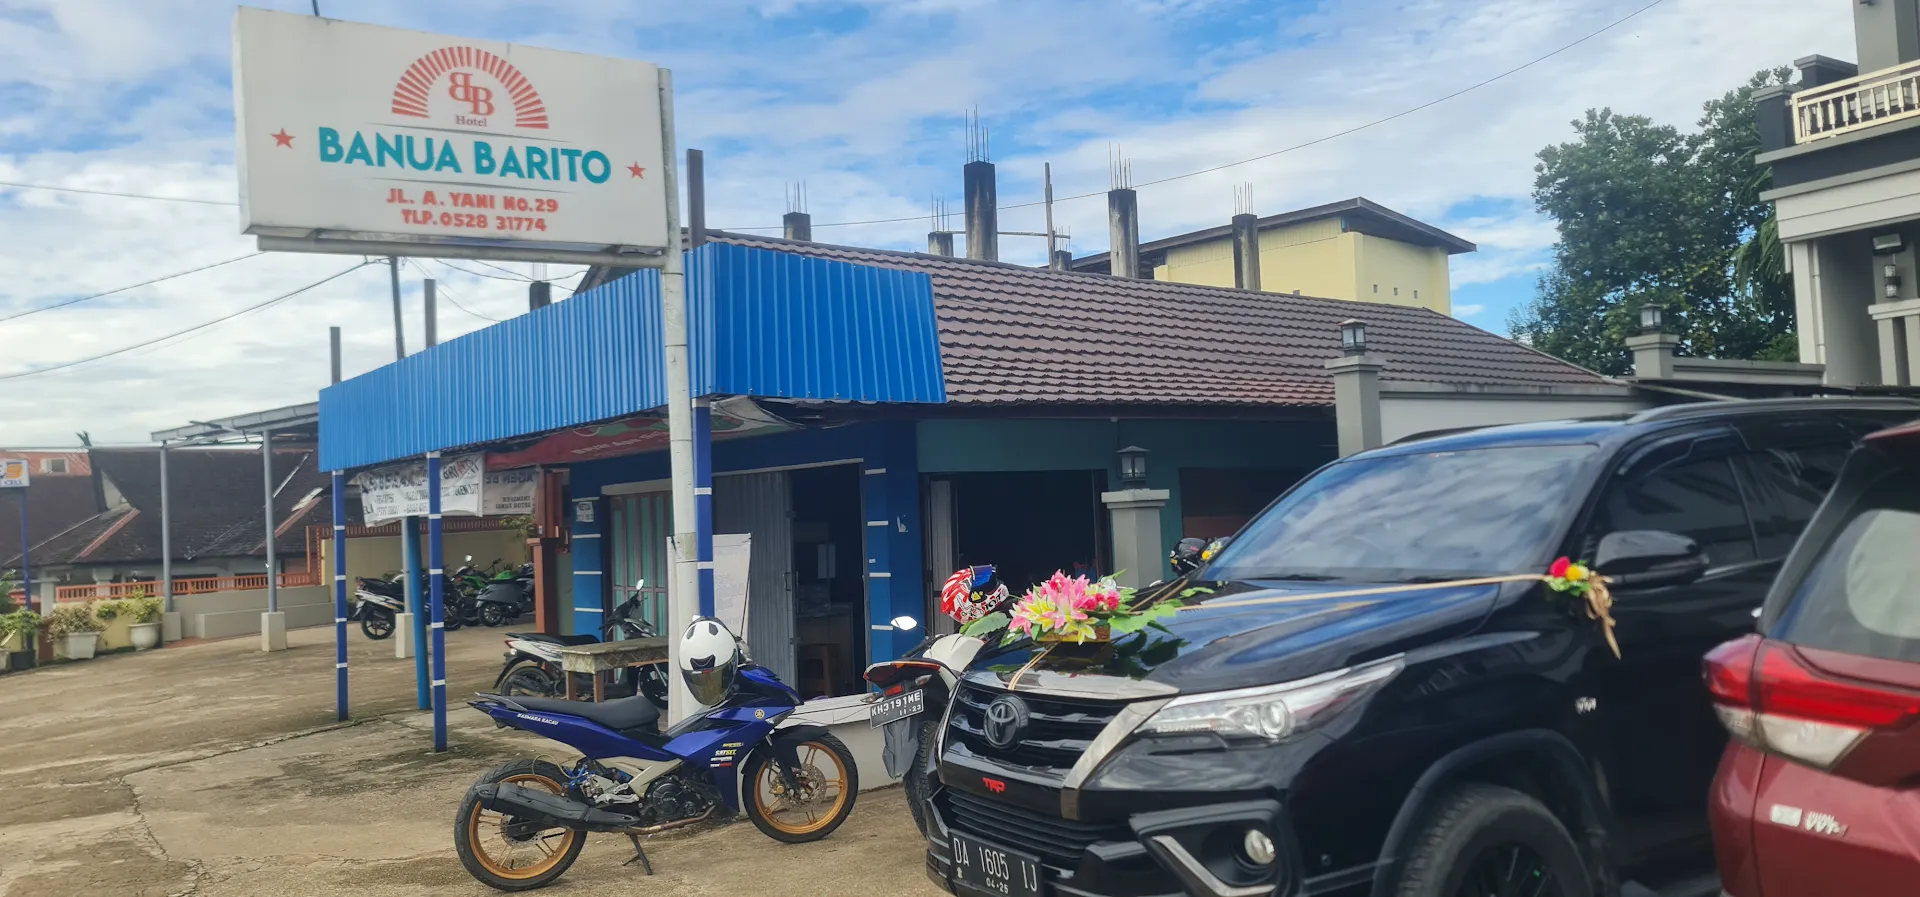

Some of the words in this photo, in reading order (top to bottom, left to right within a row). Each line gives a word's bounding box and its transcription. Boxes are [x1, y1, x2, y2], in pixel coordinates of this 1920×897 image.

[455, 115, 488, 128] Hotel
[318, 126, 461, 174] BANUA
[474, 140, 611, 184] BARITO
[386, 188, 414, 204] JL.
[423, 190, 445, 206] A.
[450, 192, 495, 209] YANI
[496, 214, 547, 232] 31774
[953, 837, 970, 867] DA
[978, 846, 1010, 881] 1605
